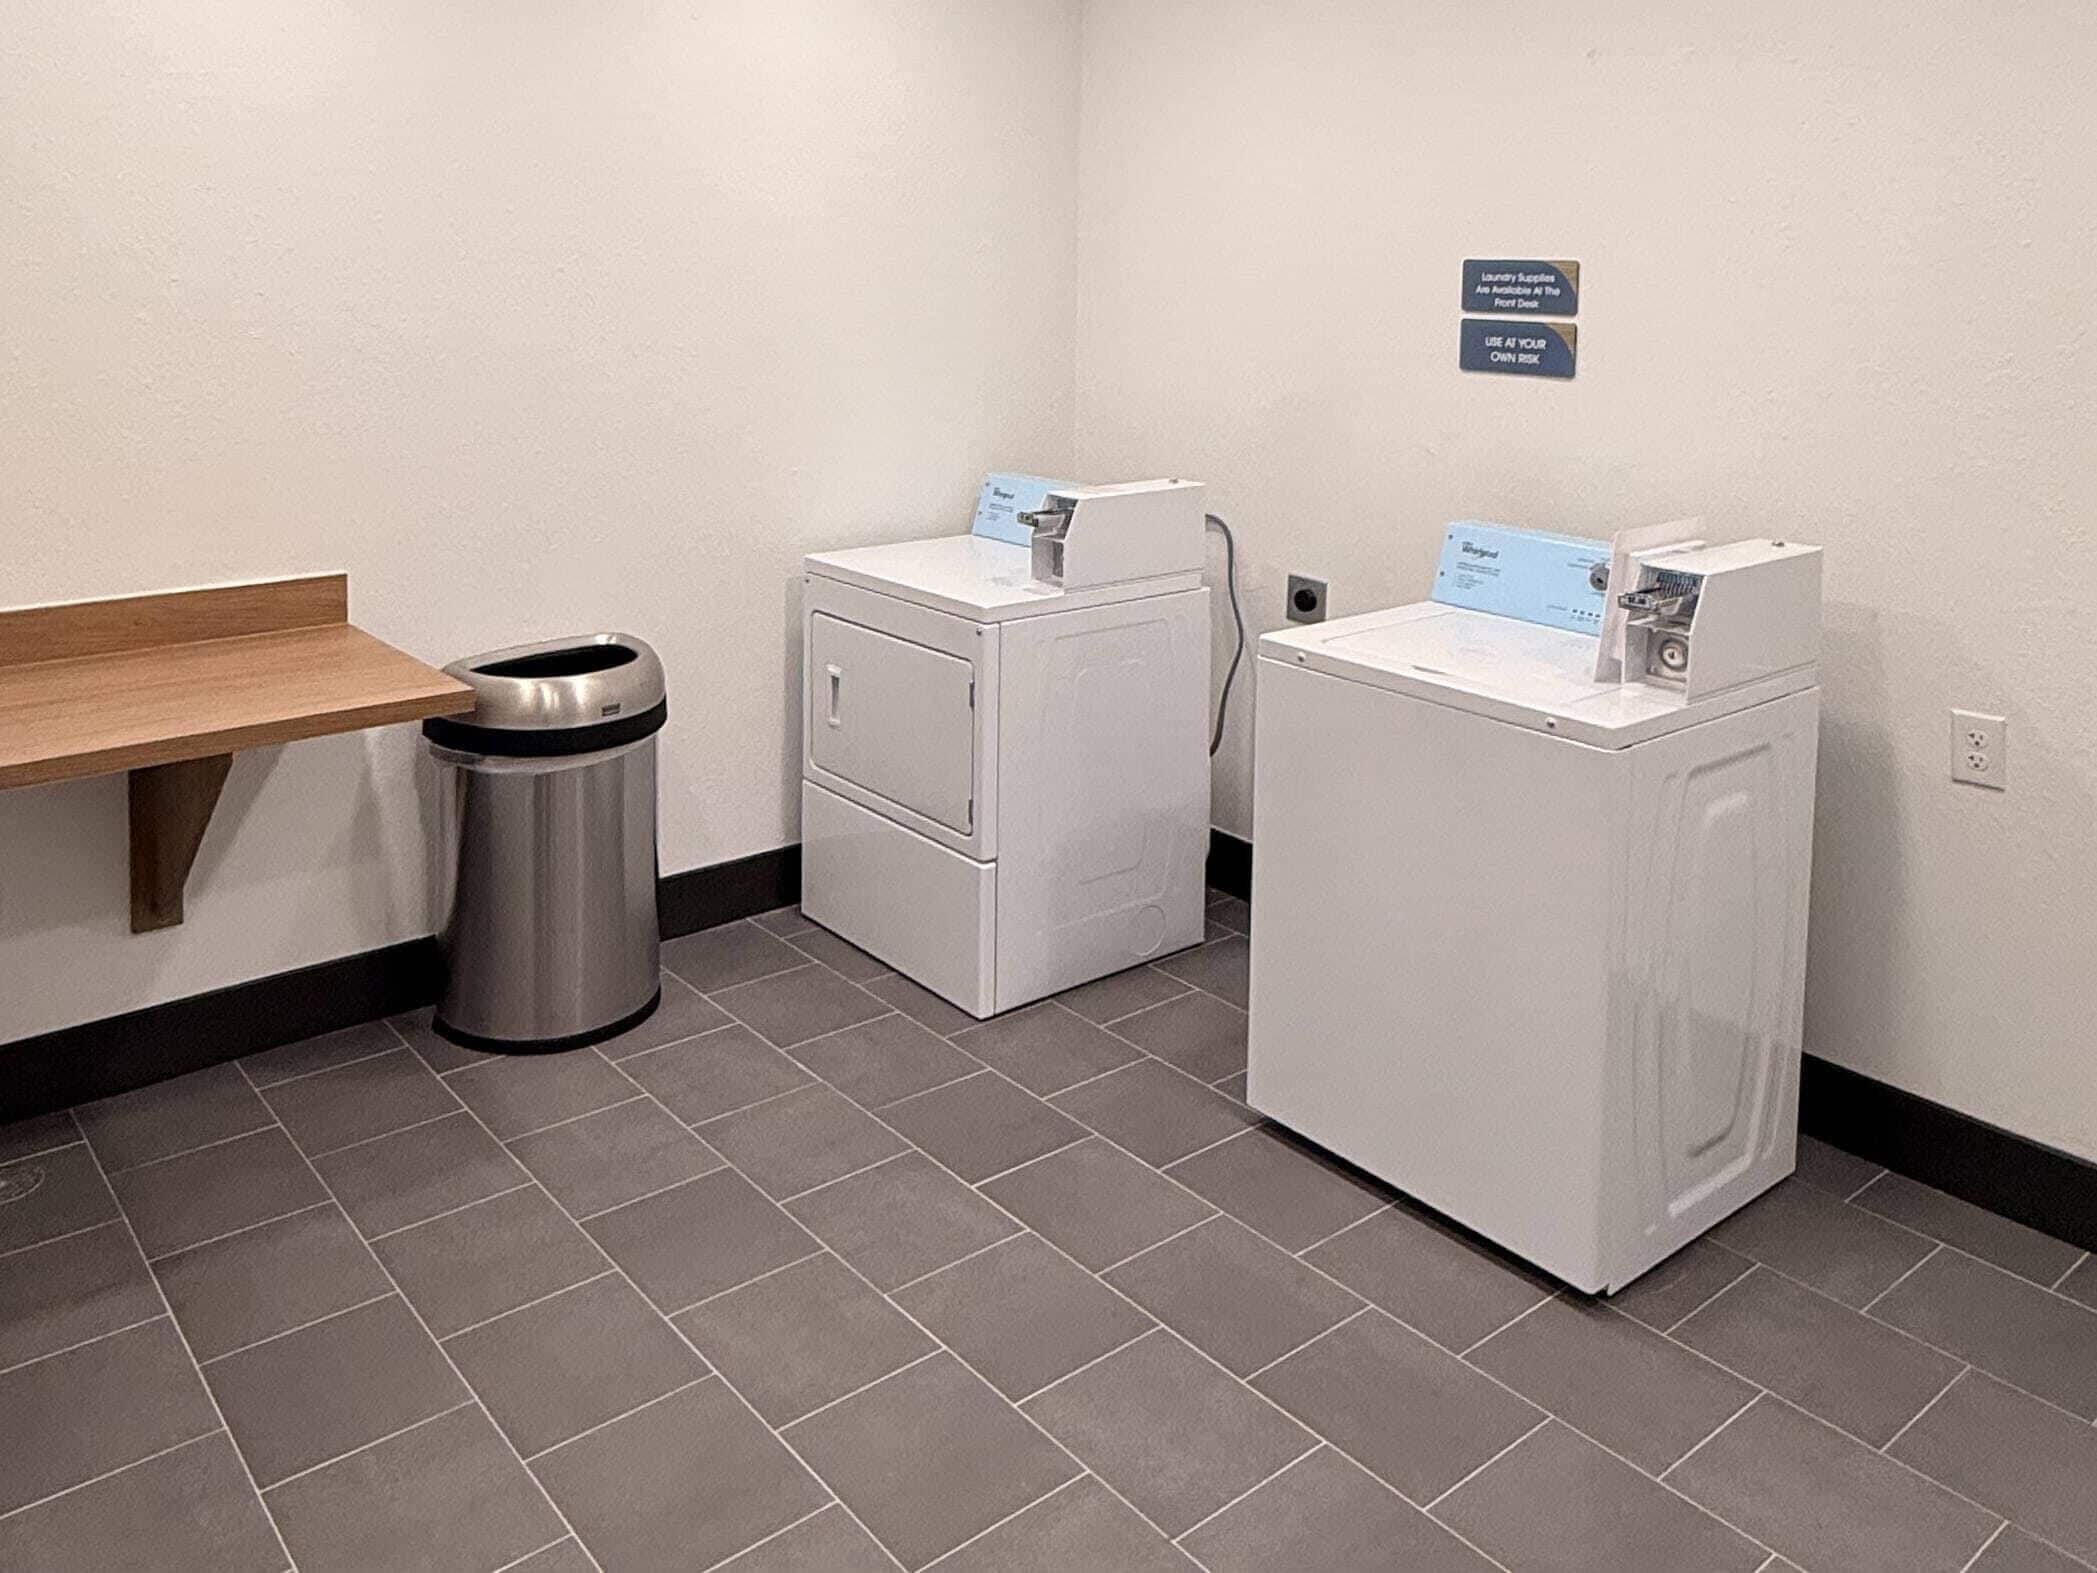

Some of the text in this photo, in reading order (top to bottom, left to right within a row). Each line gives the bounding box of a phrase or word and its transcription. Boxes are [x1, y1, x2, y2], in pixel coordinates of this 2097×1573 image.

[1481, 272, 1555, 284] Laundry Supplies
[1475, 285, 1560, 297] Are Available At The
[1494, 298, 1539, 309] Front Desk
[1485, 336, 1547, 350] USE AT YOUR
[1490, 351, 1540, 364] OWN RISK
